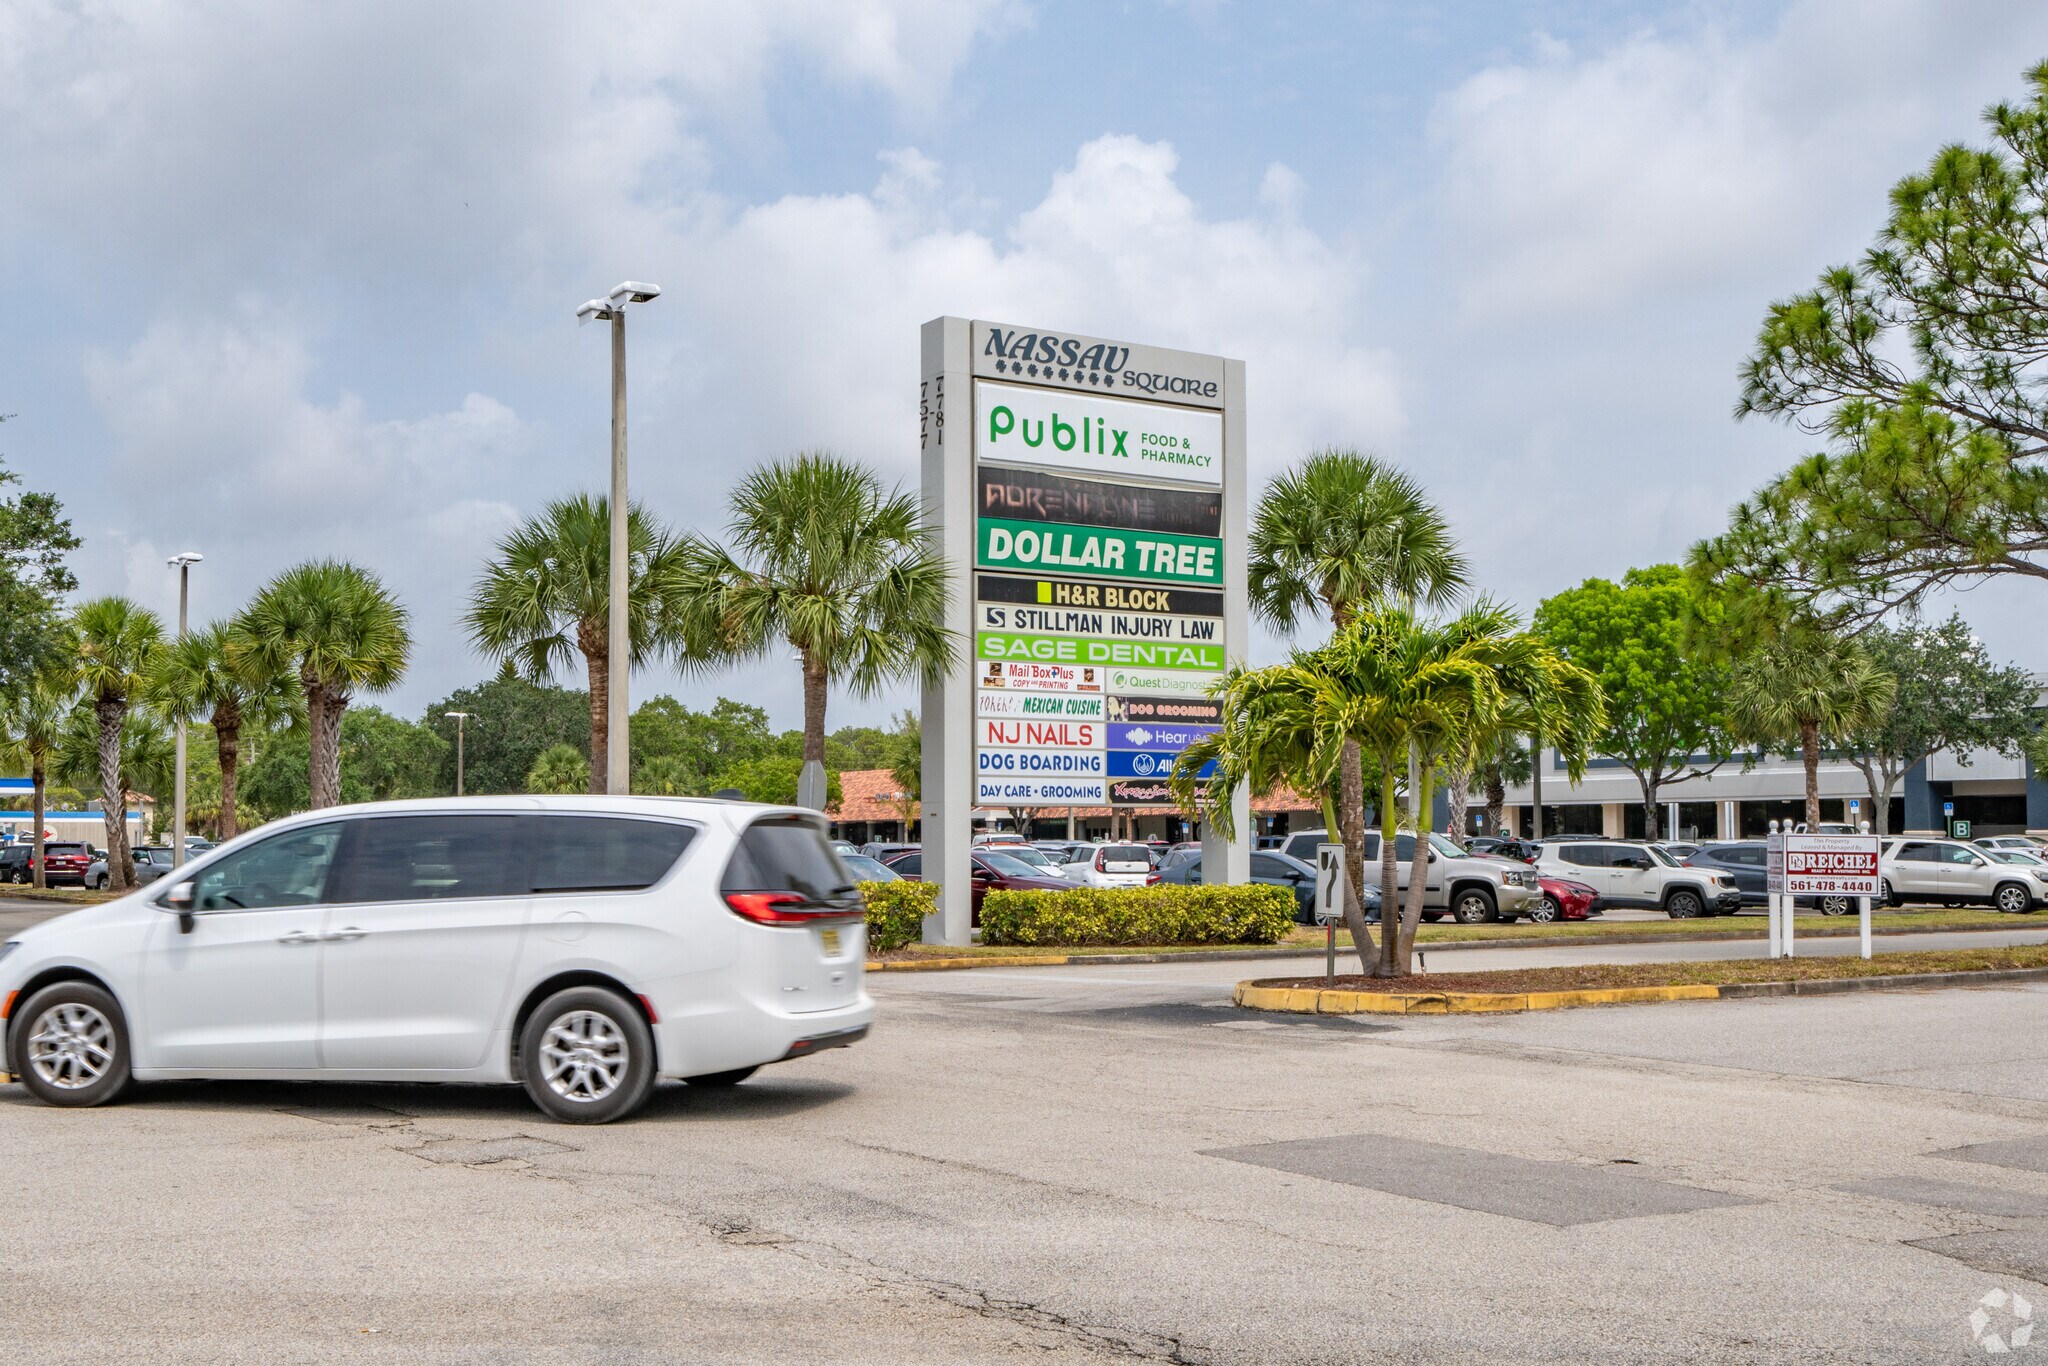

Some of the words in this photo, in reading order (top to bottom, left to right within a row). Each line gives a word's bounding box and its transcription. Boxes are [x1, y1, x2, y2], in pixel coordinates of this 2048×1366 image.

[984, 328, 1129, 373] NASSAU
[989, 405, 1129, 458] Publix
[1141, 432, 1178, 447] FOOD
[1182, 437, 1191, 449] &
[1141, 449, 1212, 468] PHARMACY
[988, 527, 1126, 570] DOLLAR
[1135, 540, 1216, 577] TREE
[1056, 583, 1100, 607] H&R
[1105, 588, 1170, 612] BLOCK
[1014, 608, 1102, 634] STILLMAN
[1111, 616, 1172, 638] INJURY
[1181, 620, 1215, 640] LAW
[984, 637, 1077, 660] SAGE
[1089, 642, 1218, 667] DENTAL
[1009, 664, 1030, 678] Mail
[1012, 679, 1030, 688] COPY
[1038, 680, 1069, 690] PRINTING
[1130, 676, 1161, 688] Quest
[1162, 678, 1207, 691] Diagnost
[1023, 697, 1064, 714] MEXICAN
[1066, 699, 1101, 716] CUISINE
[988, 721, 1021, 744] NJ
[1026, 723, 1093, 746] NAILS
[979, 753, 1015, 770] DOG
[1020, 754, 1101, 772] BOARDING
[980, 784, 1002, 797] DAY
[1004, 784, 1031, 798] CARE
[1041, 785, 1101, 799] GROOMING
[1956, 823, 1967, 835] B
[1805, 853, 1876, 869] REICHEL
[1790, 880, 1872, 892] 561-478-4440
